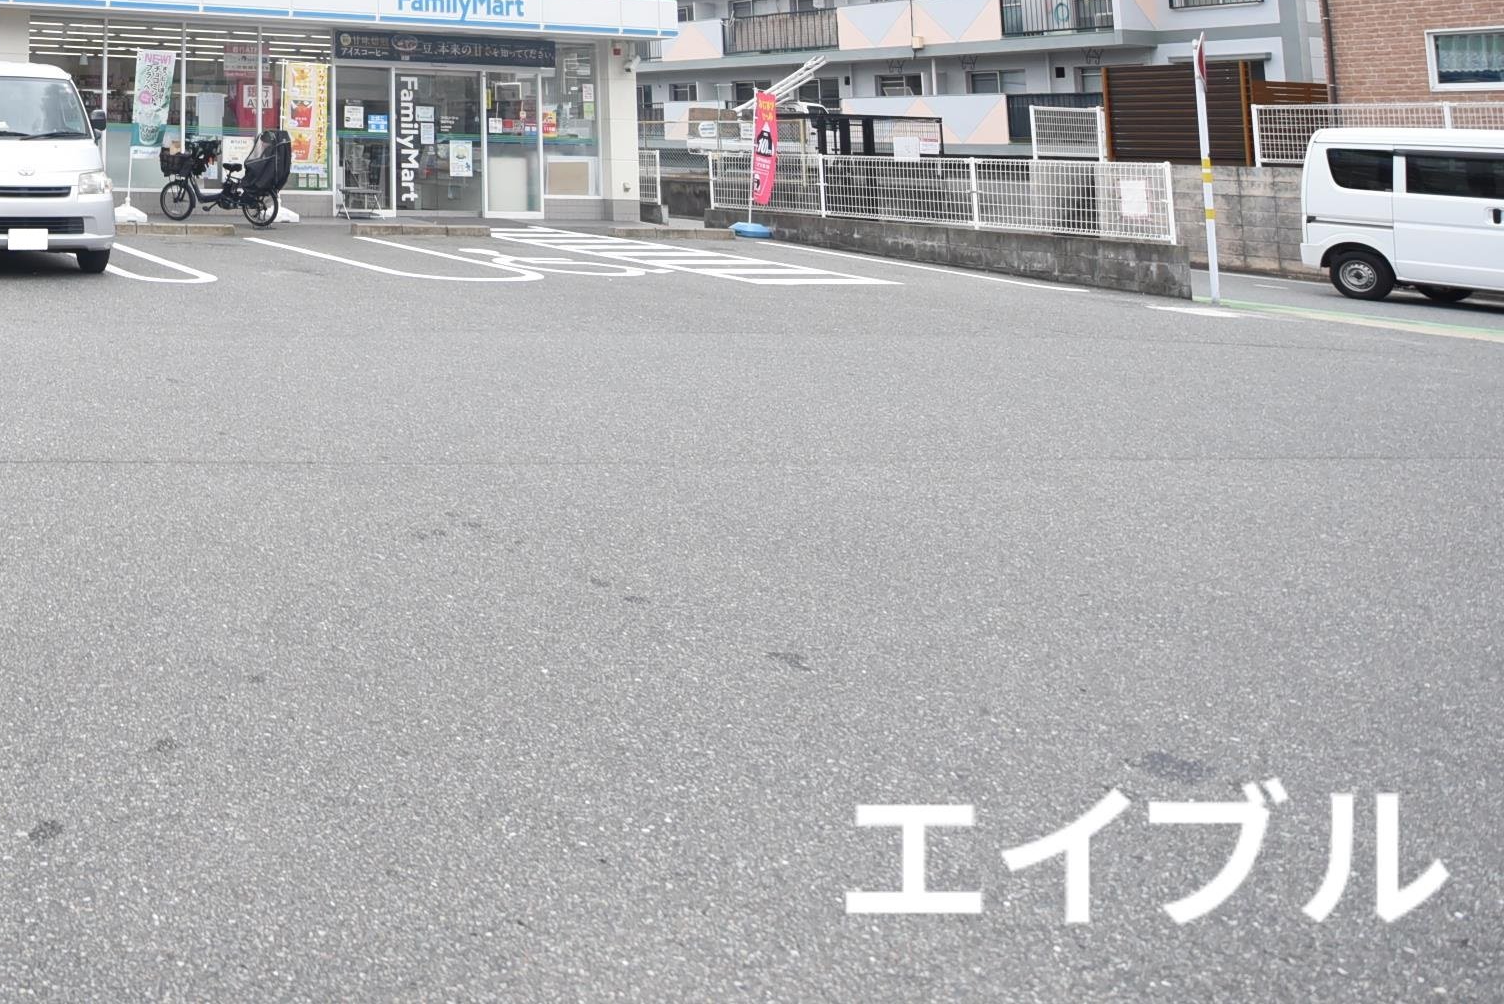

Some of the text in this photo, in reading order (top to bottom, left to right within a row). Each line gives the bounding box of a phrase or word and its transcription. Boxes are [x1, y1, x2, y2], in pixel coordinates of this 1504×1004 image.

[340, 47, 389, 57] アイスコーヒー
[247, 99, 269, 107] AM
[396, 76, 419, 202] FamilyMart
